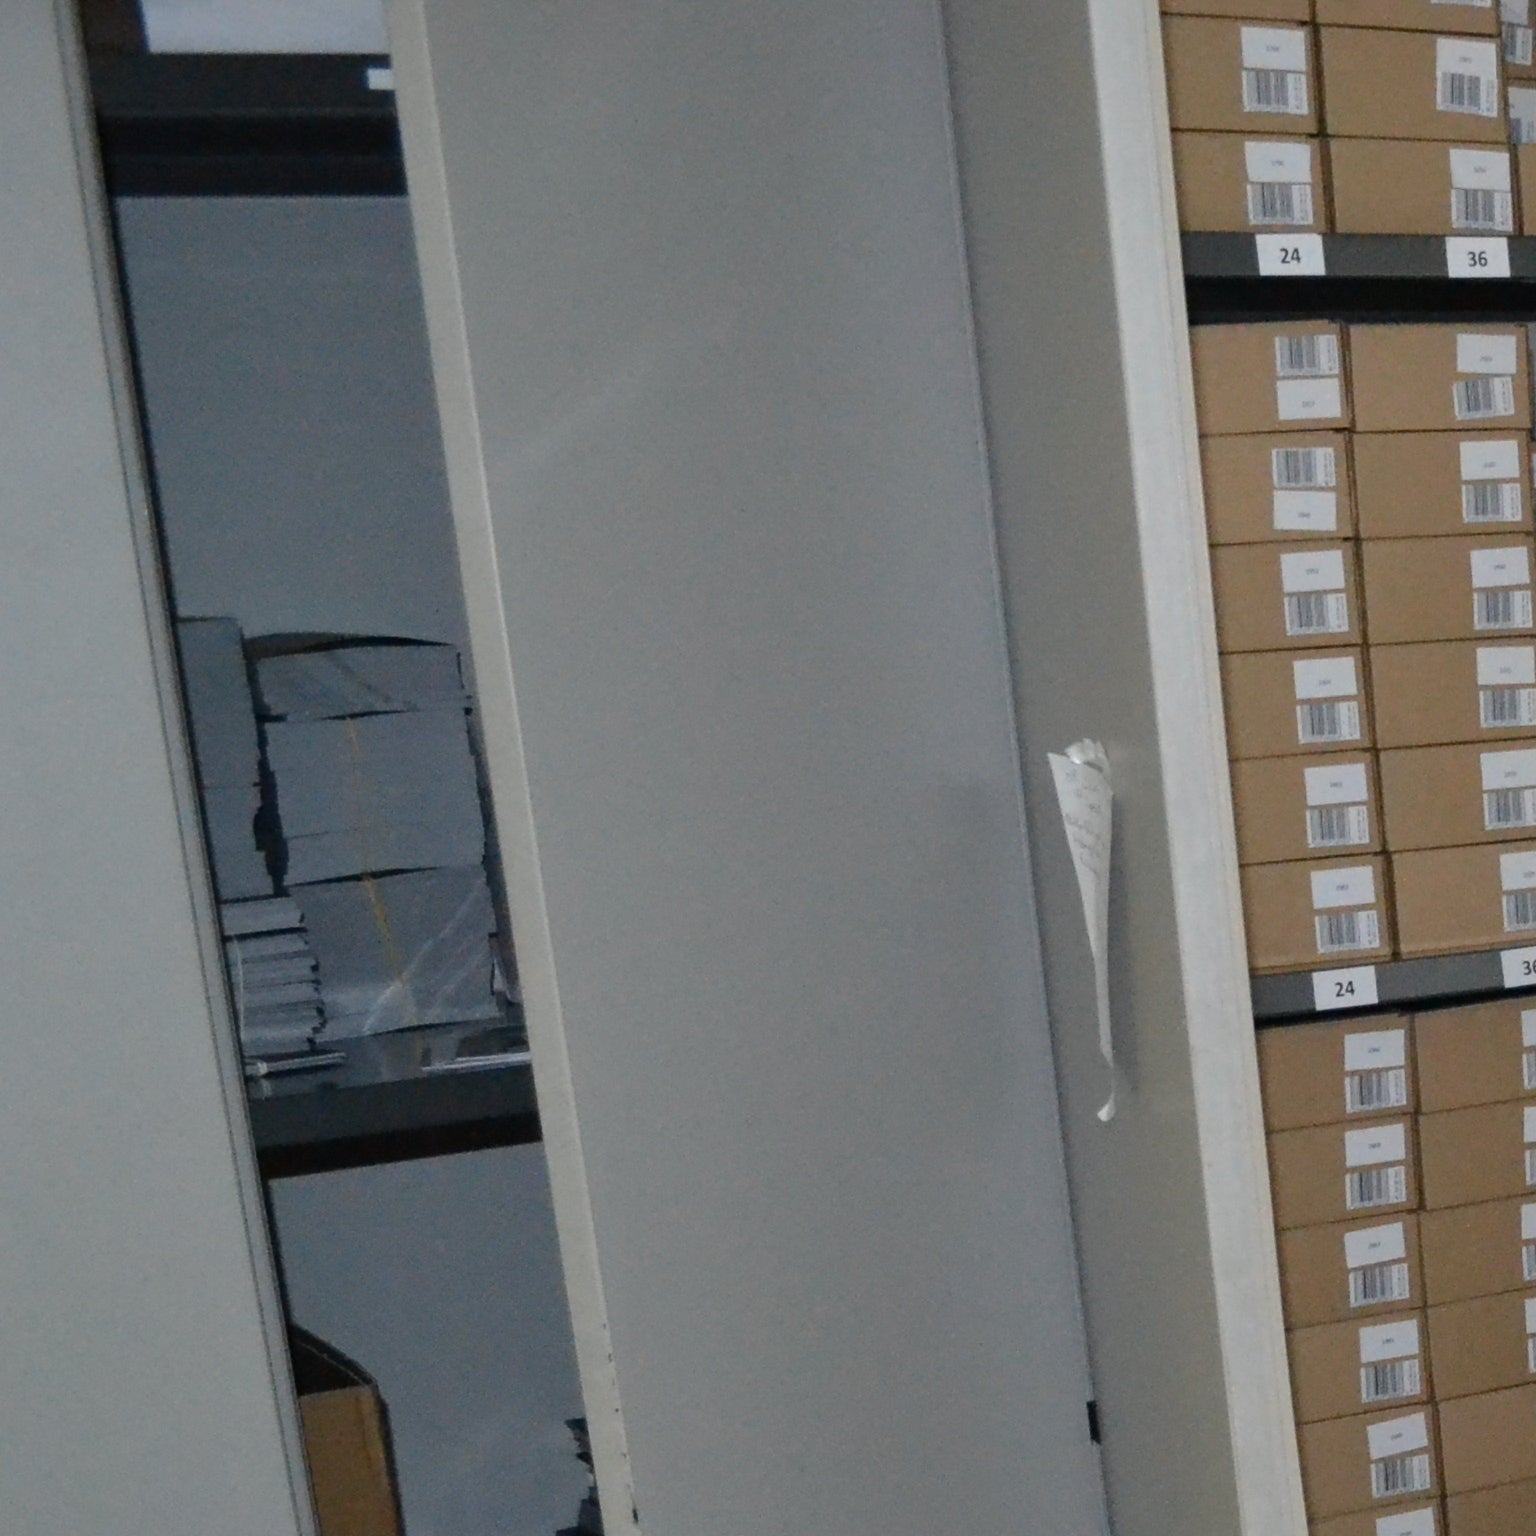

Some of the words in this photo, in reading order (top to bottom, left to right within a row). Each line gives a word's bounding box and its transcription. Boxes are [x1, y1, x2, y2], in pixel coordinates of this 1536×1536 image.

[1279, 246, 1302, 265] 24
[1466, 250, 1489, 268] 36
[1334, 979, 1355, 998] 24
